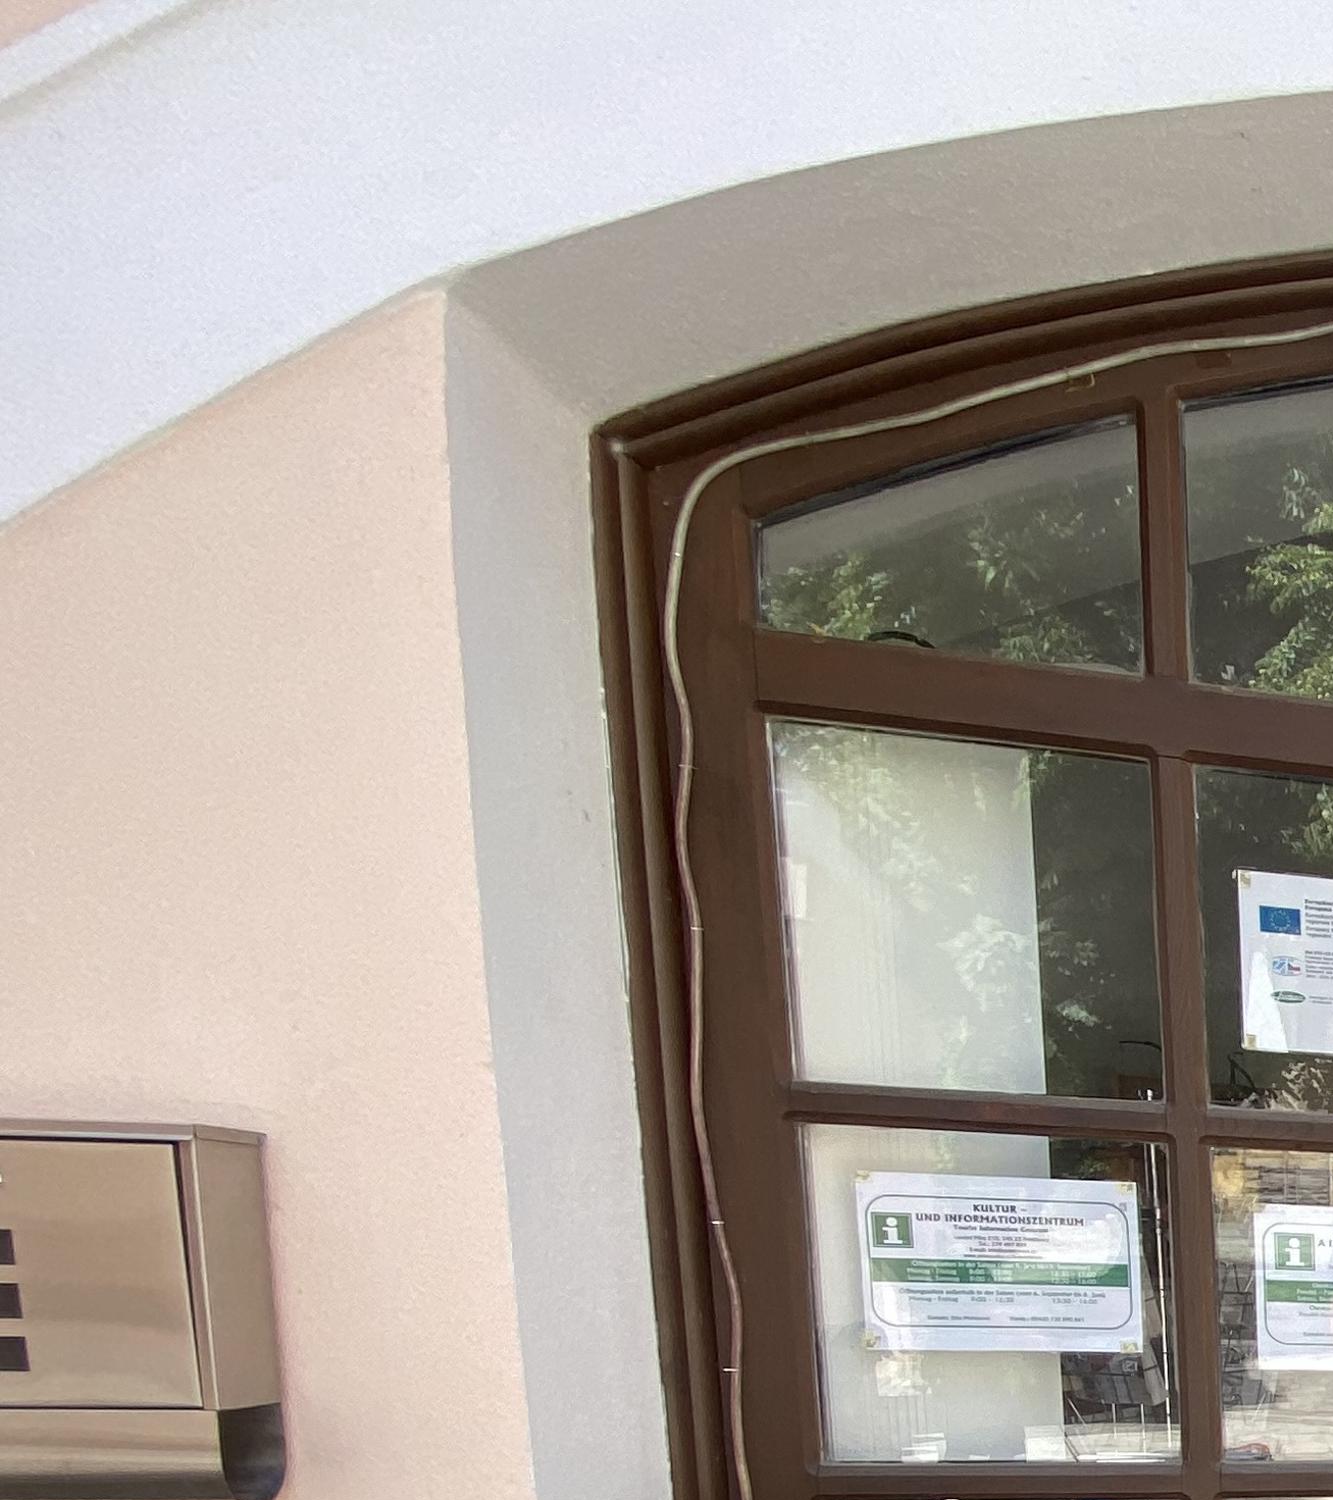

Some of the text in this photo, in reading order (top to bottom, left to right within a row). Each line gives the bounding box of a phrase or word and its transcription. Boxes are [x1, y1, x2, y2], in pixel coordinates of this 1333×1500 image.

[973, 1203, 1017, 1214] KULTUR
[916, 1213, 1084, 1227] UND INFORMATIONSZENTRUM
